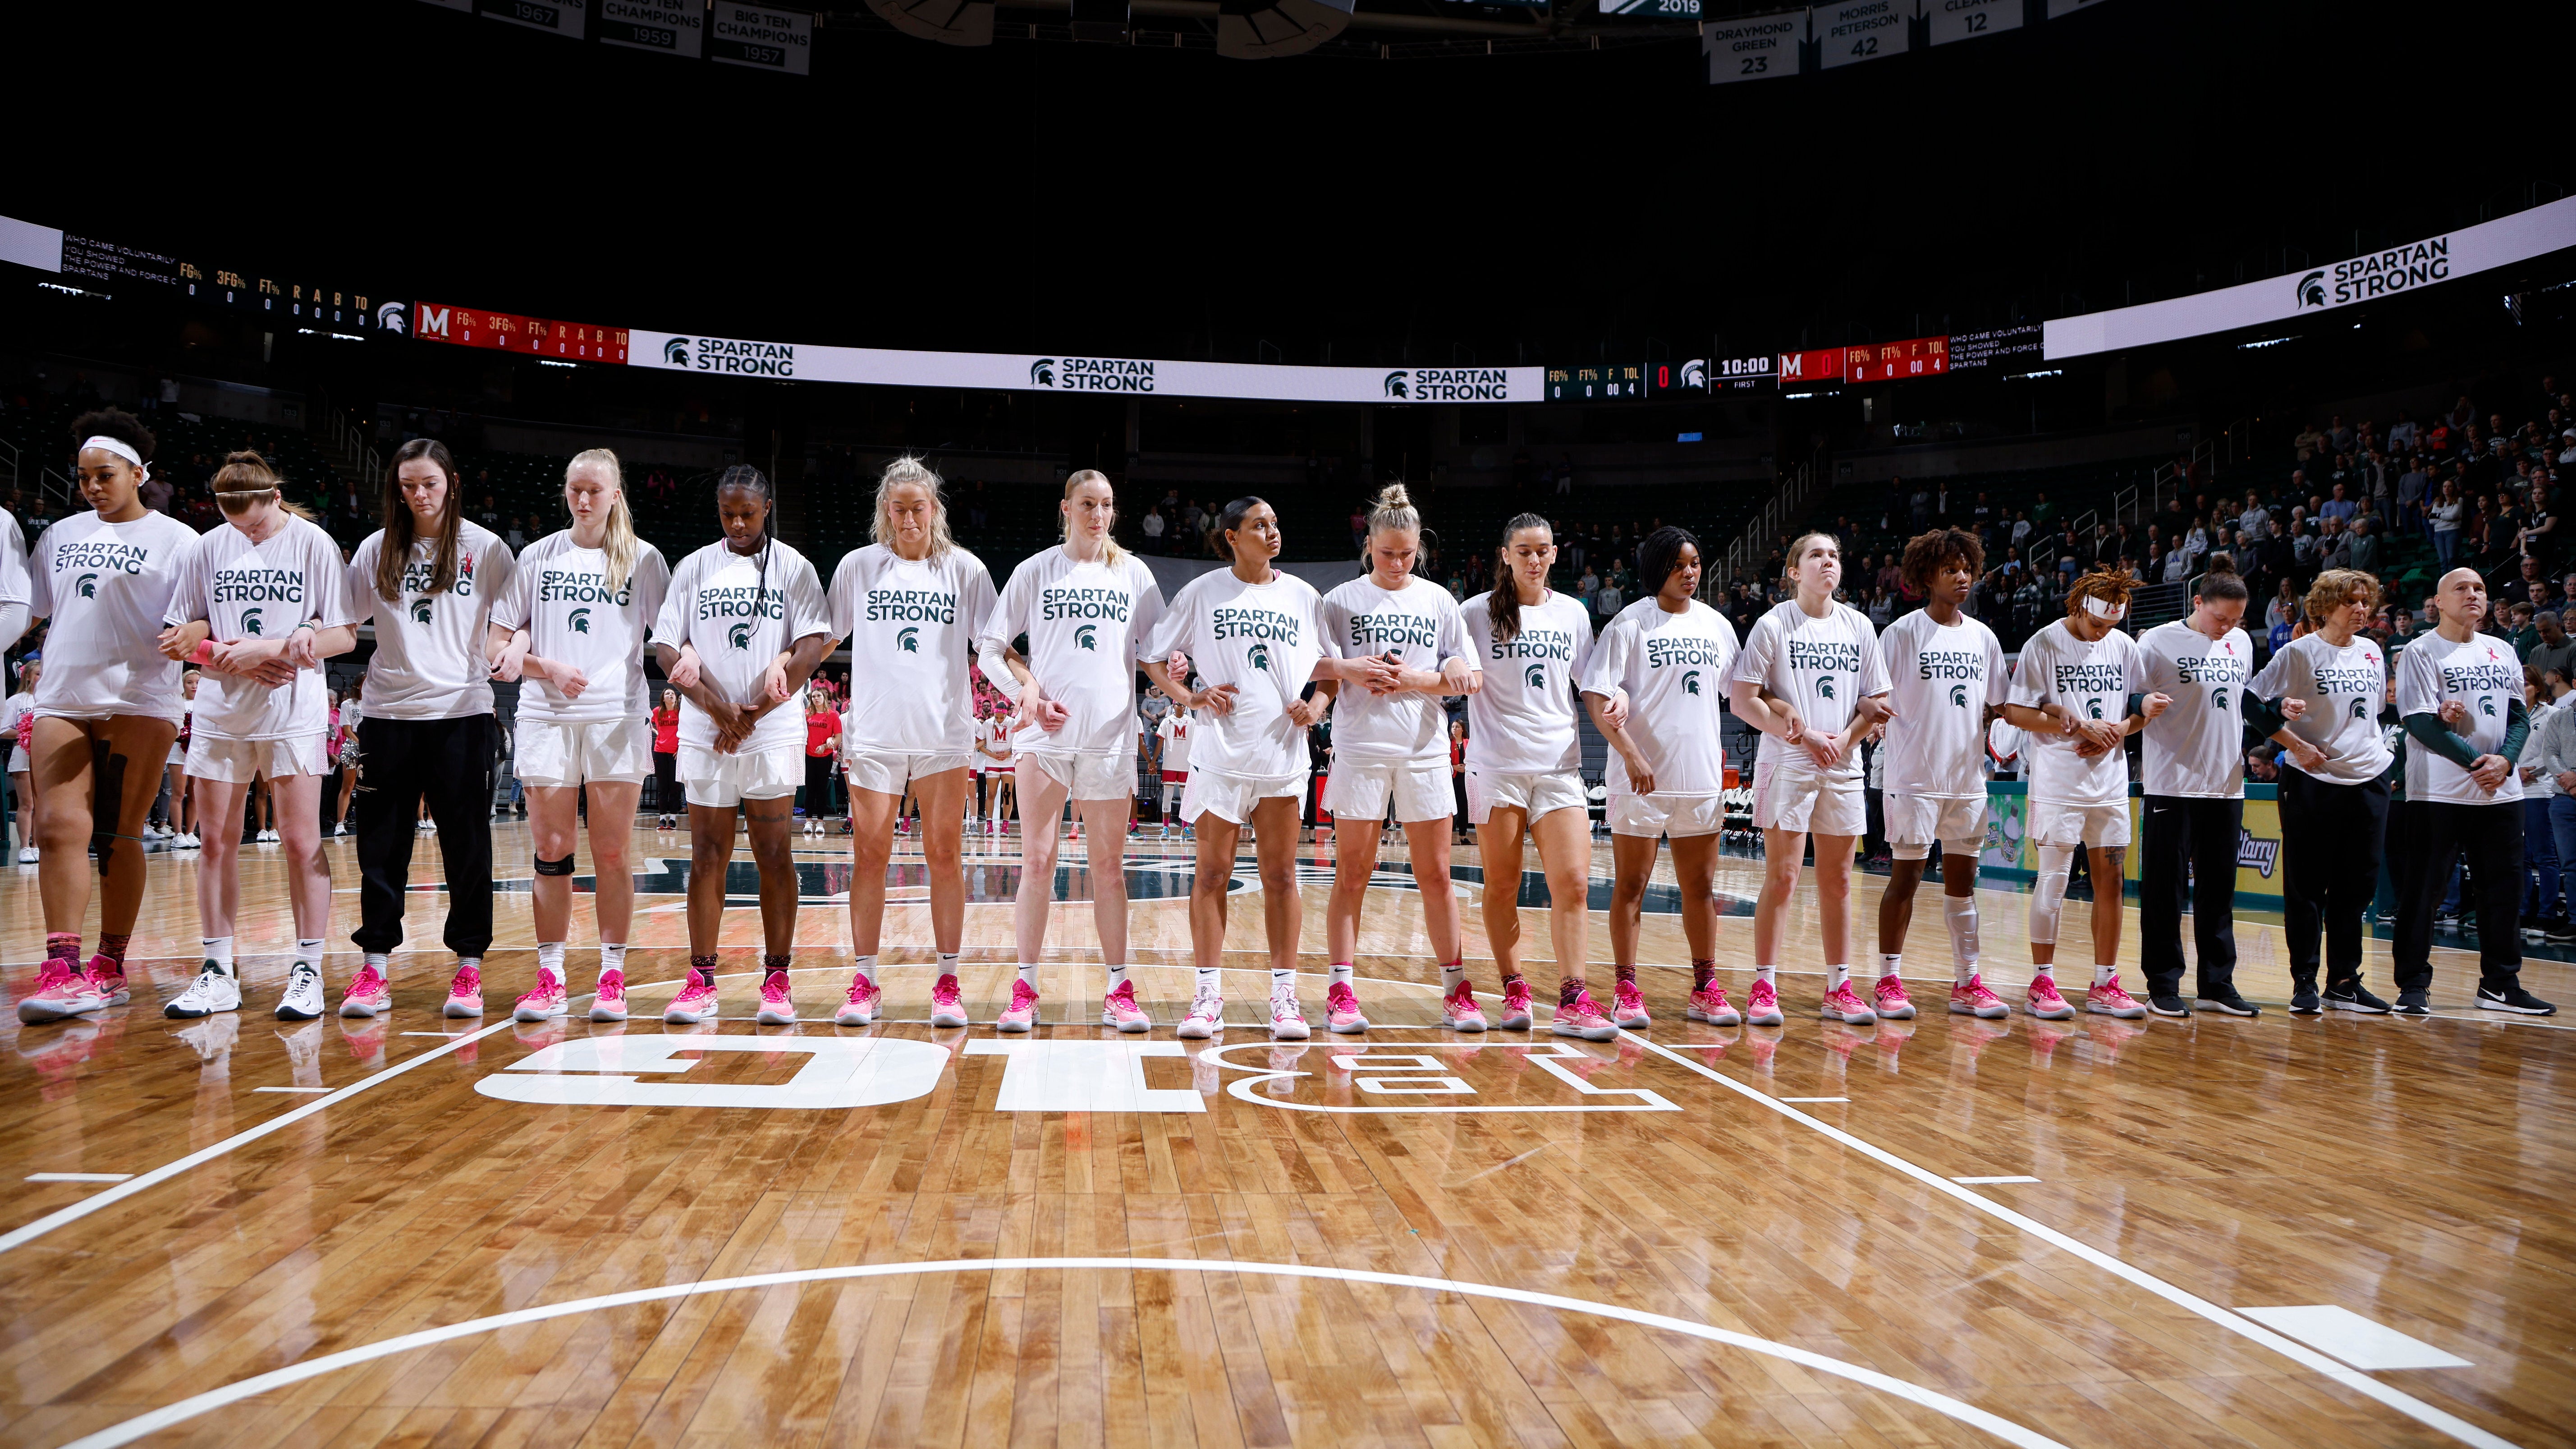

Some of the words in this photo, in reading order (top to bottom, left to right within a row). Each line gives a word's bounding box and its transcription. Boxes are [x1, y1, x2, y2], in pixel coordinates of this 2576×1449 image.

[514, 3, 555, 23] 1967
[606, 3, 700, 28] CHAMPIONS
[1659, 0, 1700, 13] 2019
[1840, 1, 1888, 22] MORRIS
[735, 10, 759, 23] BIG
[764, 14, 791, 28] TEN
[1831, 13, 1899, 37] PETERSON
[1964, 14, 1987, 33] 12
[633, 27, 672, 45] 1959
[717, 22, 808, 46] CHAMPIONS
[1716, 22, 1793, 41] DRAYMOND
[744, 46, 779, 62] 1957
[1733, 38, 1777, 52] GREEN
[1851, 37, 1878, 57] 42
[1741, 56, 1768, 74] 23
[65, 234, 87, 245] WHO
[89, 239, 115, 252] CAME
[116, 245, 176, 265] VOLUNTARILY
[65, 245, 83, 255] YOU
[86, 249, 126, 265] SHOWED
[2334, 236, 2448, 283] SPARTAN
[62, 264, 110, 280] SPARTANS
[64, 254, 82, 265] THE
[84, 258, 117, 272] POWER
[118, 266, 137, 276] AND
[139, 271, 170, 284] FORCE
[180, 262, 202, 280] FG%
[217, 271, 246, 289] 3FG%
[260, 278, 280, 296] FT%
[293, 285, 301, 299] R
[313, 289, 321, 303] A
[334, 292, 341, 306] B
[355, 295, 368, 310] TO
[2335, 257, 2449, 303] STRONG
[420, 305, 450, 336] M
[457, 312, 476, 327] FG%
[489, 316, 516, 332] 3FG%
[528, 321, 547, 336] FT%
[559, 326, 566, 339] R
[578, 328, 585, 341] A
[596, 330, 603, 342] B
[616, 332, 627, 345] TO
[1950, 335, 1967, 343] WHO
[1969, 332, 1990, 341] CAME
[1992, 324, 2042, 338] VOLUNTARILY
[698, 338, 793, 359] SPARTAN
[1850, 350, 1870, 363] FG%
[1881, 346, 1901, 359] FT%
[1912, 344, 1916, 356] F
[1928, 341, 1944, 354] TOL
[1966, 349, 1994, 359] POWER
[2013, 343, 2037, 353] FORCE
[1968, 340, 2000, 350] SHOWED
[697, 353, 793, 376] STRONG
[1063, 358, 1154, 375] SPARTAN
[1722, 357, 1769, 375] 10:00
[1781, 354, 1802, 377] M
[1822, 353, 1832, 376] 0
[1910, 361, 1922, 374] 00
[1934, 358, 1940, 371] 4
[1949, 359, 1987, 370] SPARTANS
[1062, 373, 1154, 391] STRONG
[1416, 369, 1506, 383] SPARTAN
[1549, 370, 1568, 382] FG%
[1579, 368, 1598, 381] FT%
[1608, 368, 1613, 380] F
[1623, 367, 1639, 380] TOL
[1659, 366, 1668, 388] 0
[1416, 384, 1507, 400] STRONG
[1607, 383, 1619, 395] 00
[1628, 382, 1635, 395] 4
[1734, 381, 1756, 389] FIRST
[283, 408, 297, 417] 133
[57, 543, 147, 562] SPARTAN
[55, 554, 142, 574] STRONG
[215, 569, 303, 586] SPARTAN
[215, 585, 302, 603] STRONG
[540, 586, 629, 606] STRONG
[700, 587, 784, 604] SPARTAN
[867, 590, 955, 608] SPARTAN
[1043, 589, 1129, 606] SPARTAN
[700, 601, 783, 620] STRONG
[866, 605, 954, 624] STRONG
[1043, 603, 1128, 622] STRONG
[1214, 609, 1298, 632] SPARTAN
[1350, 614, 1435, 632] SPARTAN
[1214, 622, 1297, 647] STRONG
[1352, 628, 1434, 648] STRONG
[1492, 642, 1570, 661] STRONG
[1647, 637, 1719, 653] SPARTAN
[1790, 640, 1859, 657] SPARTAN
[1650, 650, 1719, 669] STRONG
[1790, 655, 1859, 673] STRONG
[1920, 652, 1983, 665] SPARTAN
[2177, 657, 2245, 670] SPARTAN
[1921, 665, 1982, 682] STRONG
[2056, 664, 2122, 678] SPARTAN
[2179, 669, 2245, 685] STRONG
[2315, 669, 2380, 682] SPARTAN
[2443, 665, 2510, 679] SPARTAN
[2057, 677, 2122, 693] STRONG
[2317, 680, 2380, 695] STRONG
[2447, 677, 2510, 693] STRONG
[995, 727, 1007, 741] M
[1173, 725, 1187, 738] M
[2237, 830, 2277, 876] tarry
